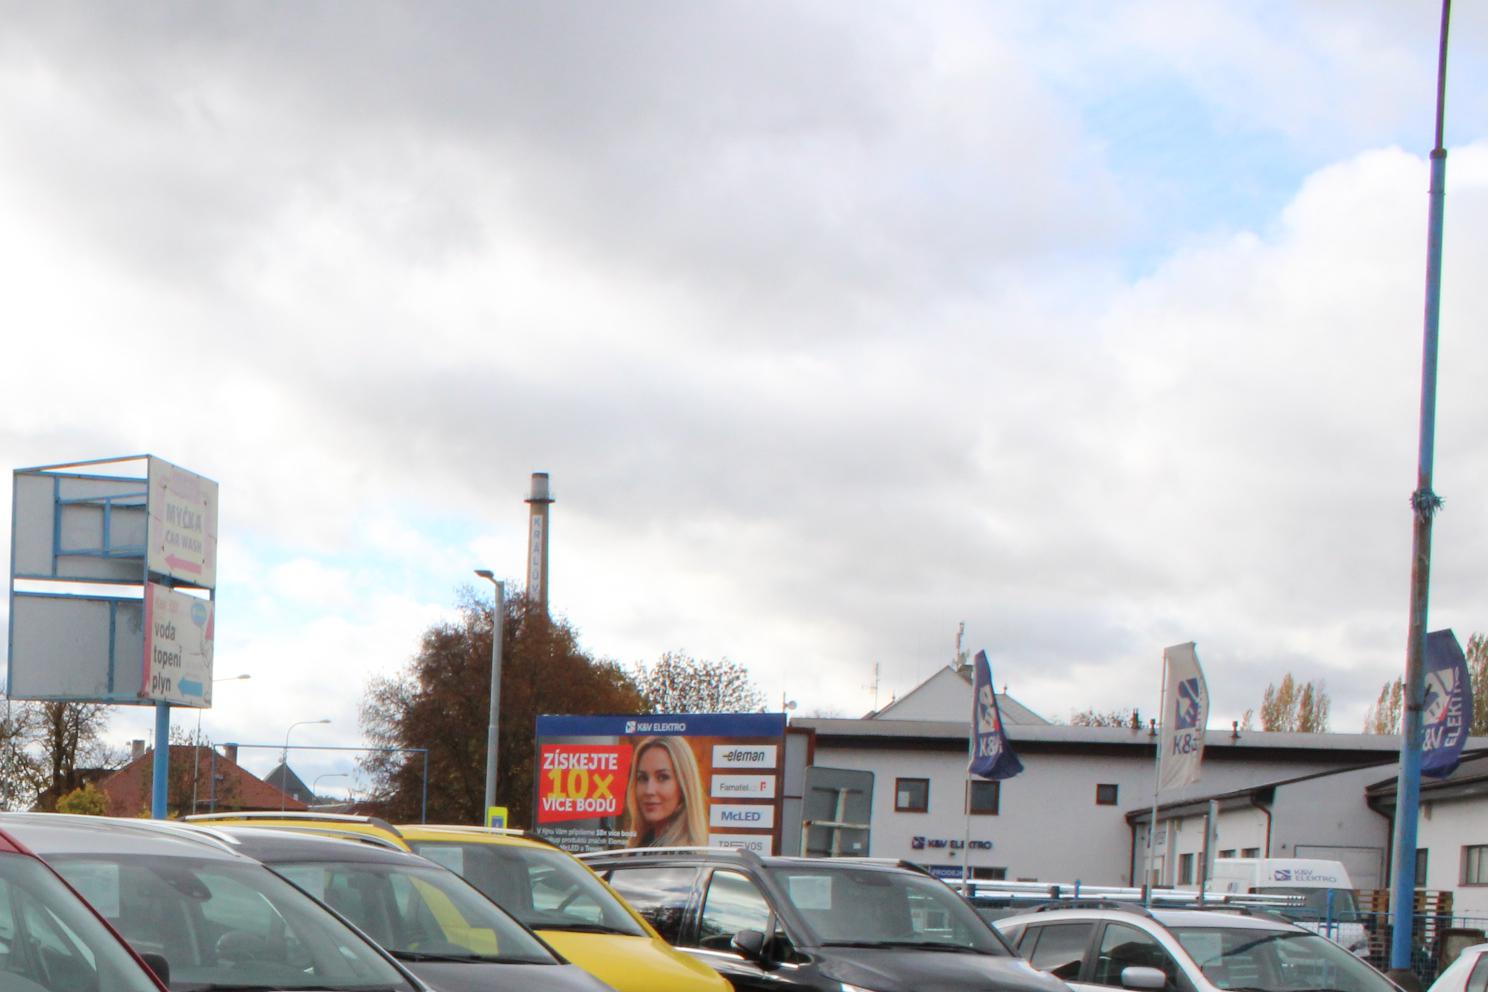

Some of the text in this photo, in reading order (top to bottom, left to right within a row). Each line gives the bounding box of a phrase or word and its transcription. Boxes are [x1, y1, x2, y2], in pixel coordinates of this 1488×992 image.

[155, 621, 176, 640] voda
[154, 645, 182, 668] topení
[152, 672, 171, 694] plyn
[653, 723, 686, 731] ELEKTRO
[543, 749, 618, 769] ZÍSKEJTE
[726, 750, 765, 761] eleman
[721, 811, 761, 821] McLED
